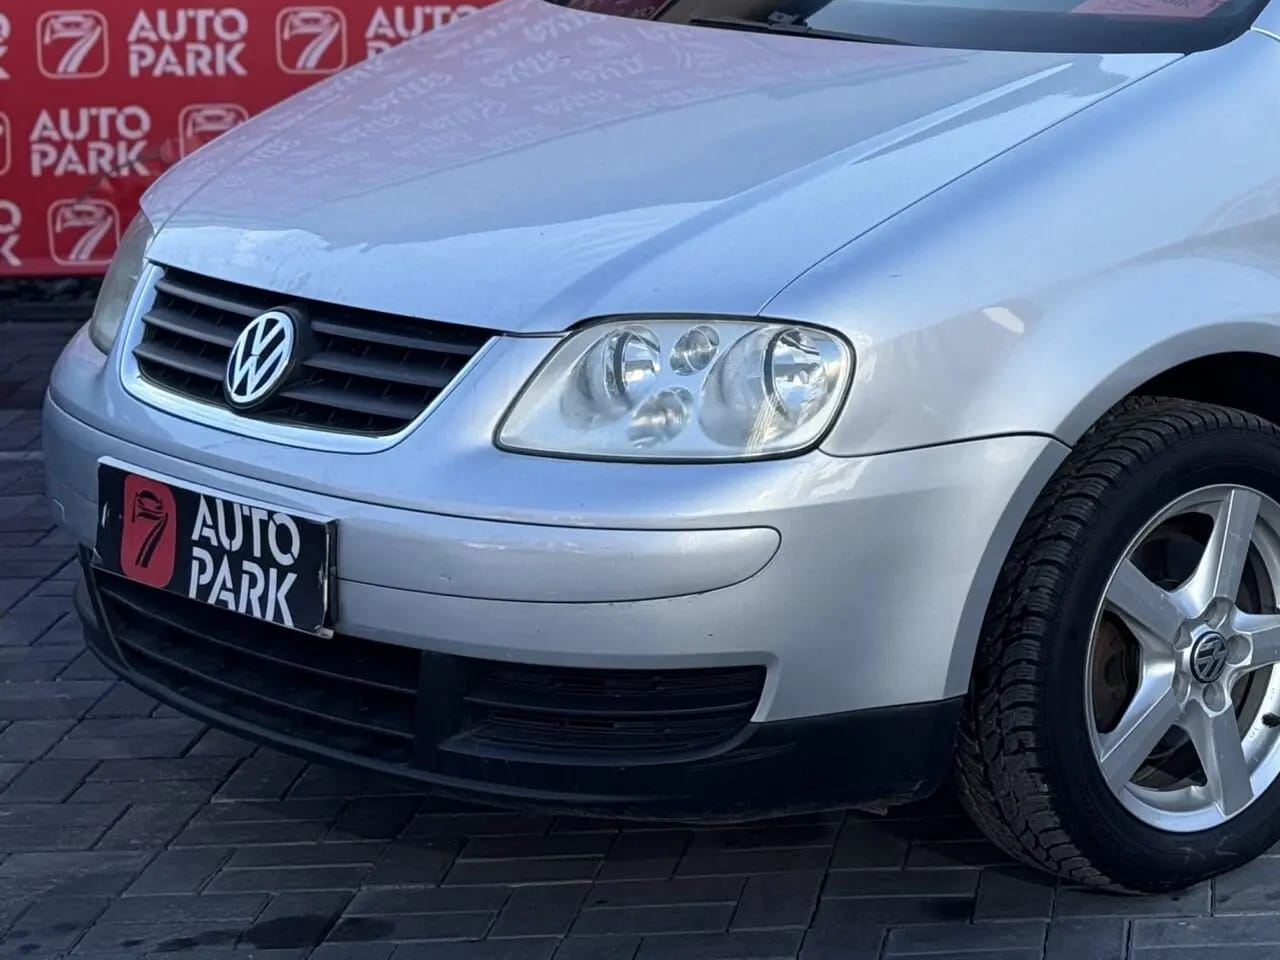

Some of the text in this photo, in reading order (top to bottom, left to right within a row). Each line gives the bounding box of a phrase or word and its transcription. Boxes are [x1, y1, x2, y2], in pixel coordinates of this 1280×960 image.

[128, 8, 248, 42] AUTO
[130, 43, 246, 76] PARK
[30, 106, 150, 140] AUTO
[31, 140, 149, 176] PARK
[191, 493, 300, 566] AUTO
[188, 547, 298, 627] PARK
